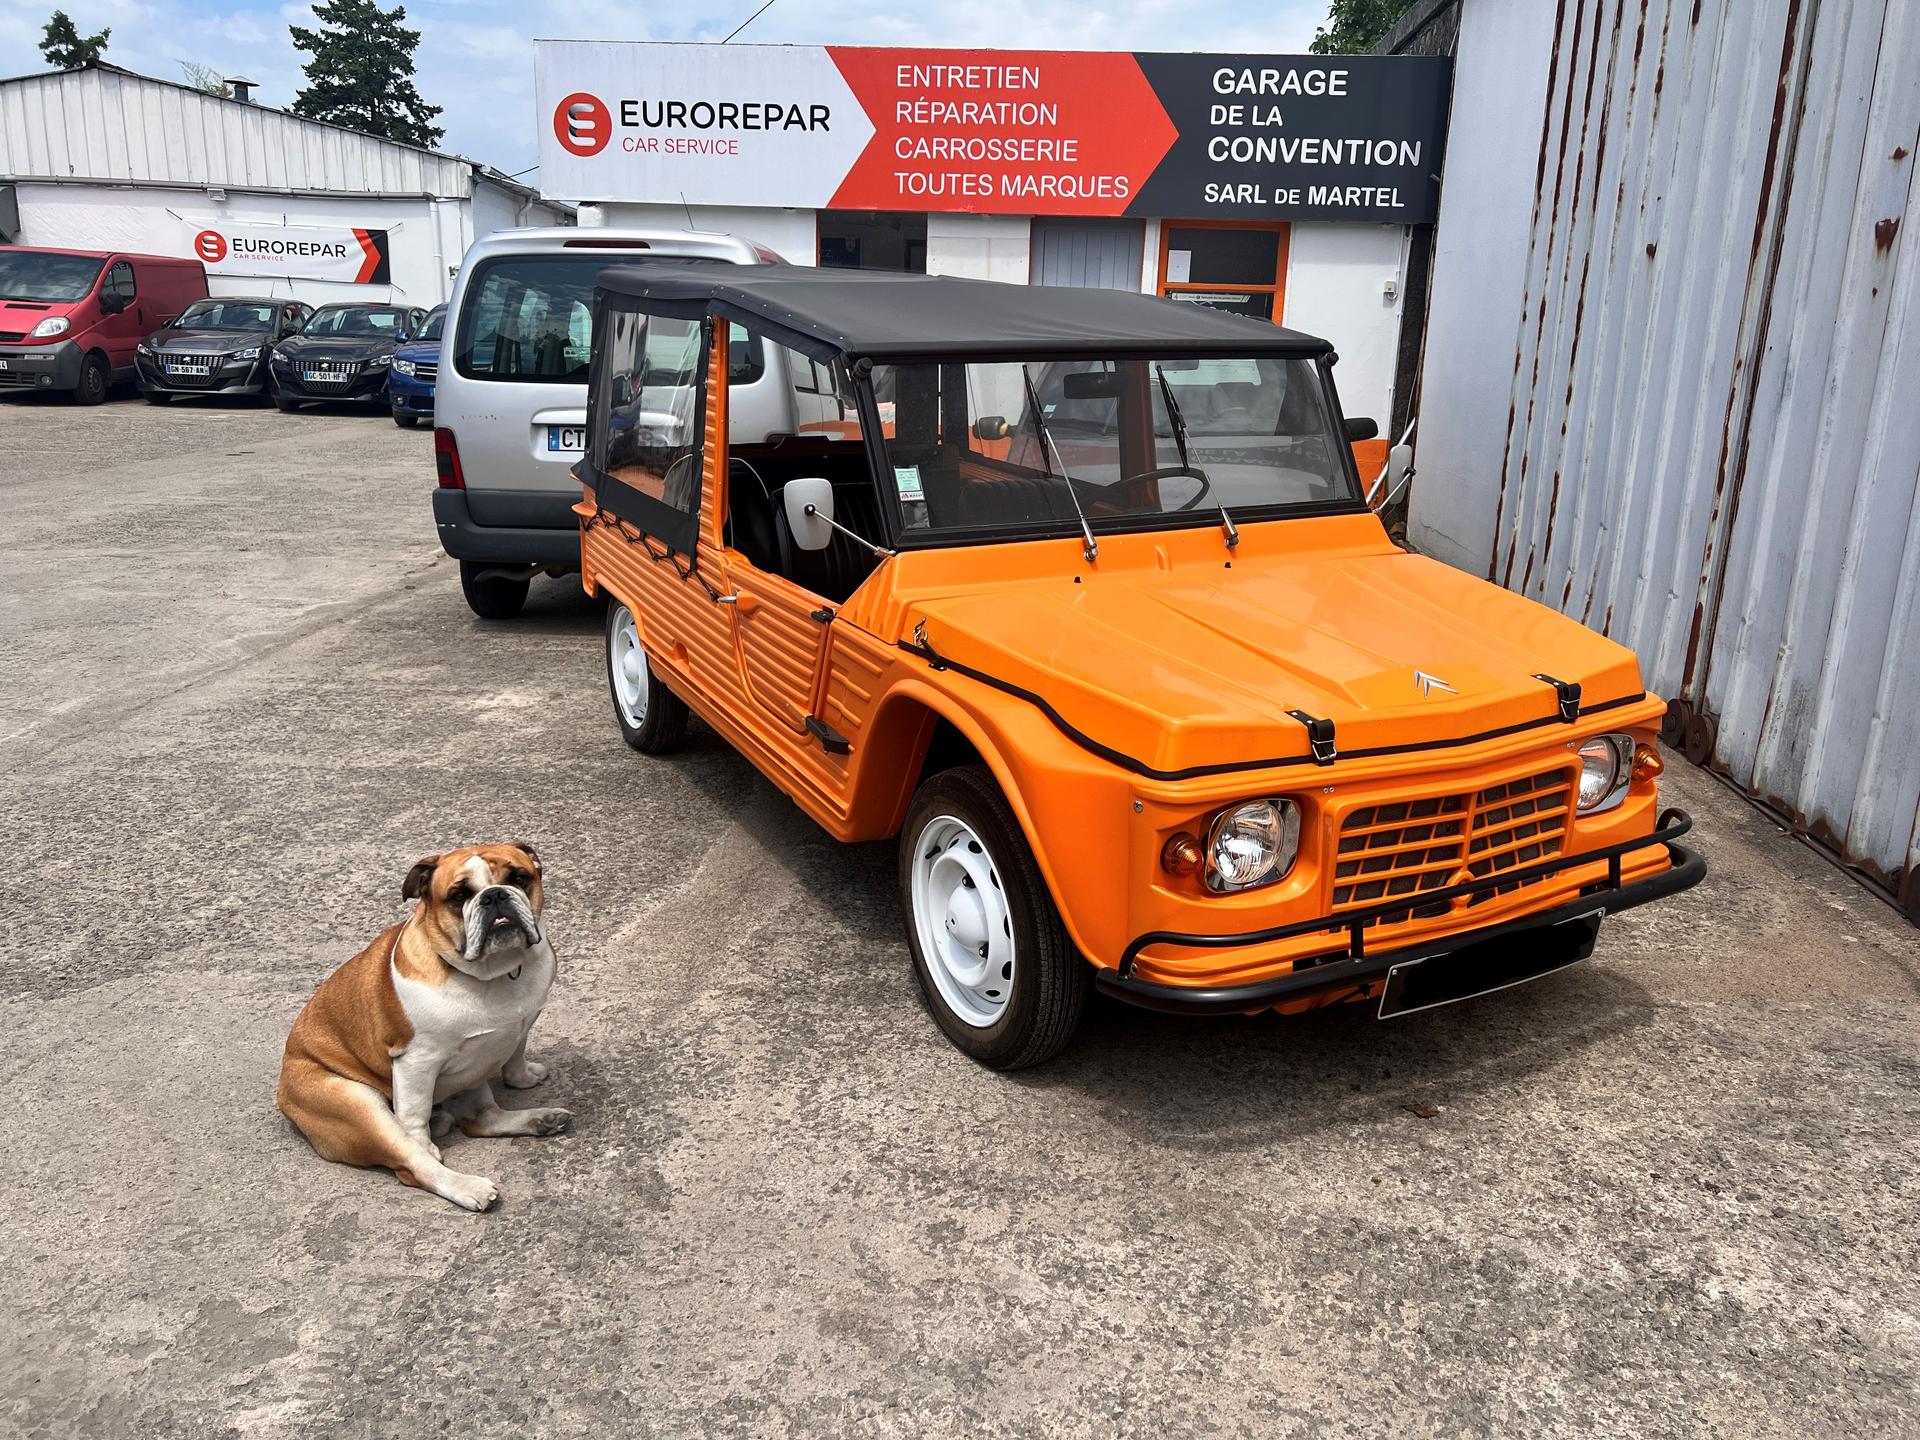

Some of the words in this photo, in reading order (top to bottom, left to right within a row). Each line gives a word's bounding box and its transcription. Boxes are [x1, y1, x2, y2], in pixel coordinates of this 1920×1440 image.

[896, 65, 1040, 89] ENTRETIEN
[1212, 67, 1349, 96] GARAGE
[620, 99, 830, 132] EUROREPAR
[896, 97, 1058, 125] RÉPARATION
[1210, 104, 1244, 126] DE
[1251, 105, 1283, 127] LA
[622, 137, 659, 153] CAR
[664, 138, 739, 155] SERVICE
[895, 137, 1079, 162] CARROSSERIE
[1207, 136, 1422, 167] CONVENTION
[894, 172, 994, 196] TOUTES
[1001, 174, 1129, 198] MARQUES
[1204, 183, 1267, 204] SARL
[1307, 185, 1405, 208] MARTEL
[232, 238, 347, 258] EUROREPAR
[251, 254, 284, 262] SERVICE
